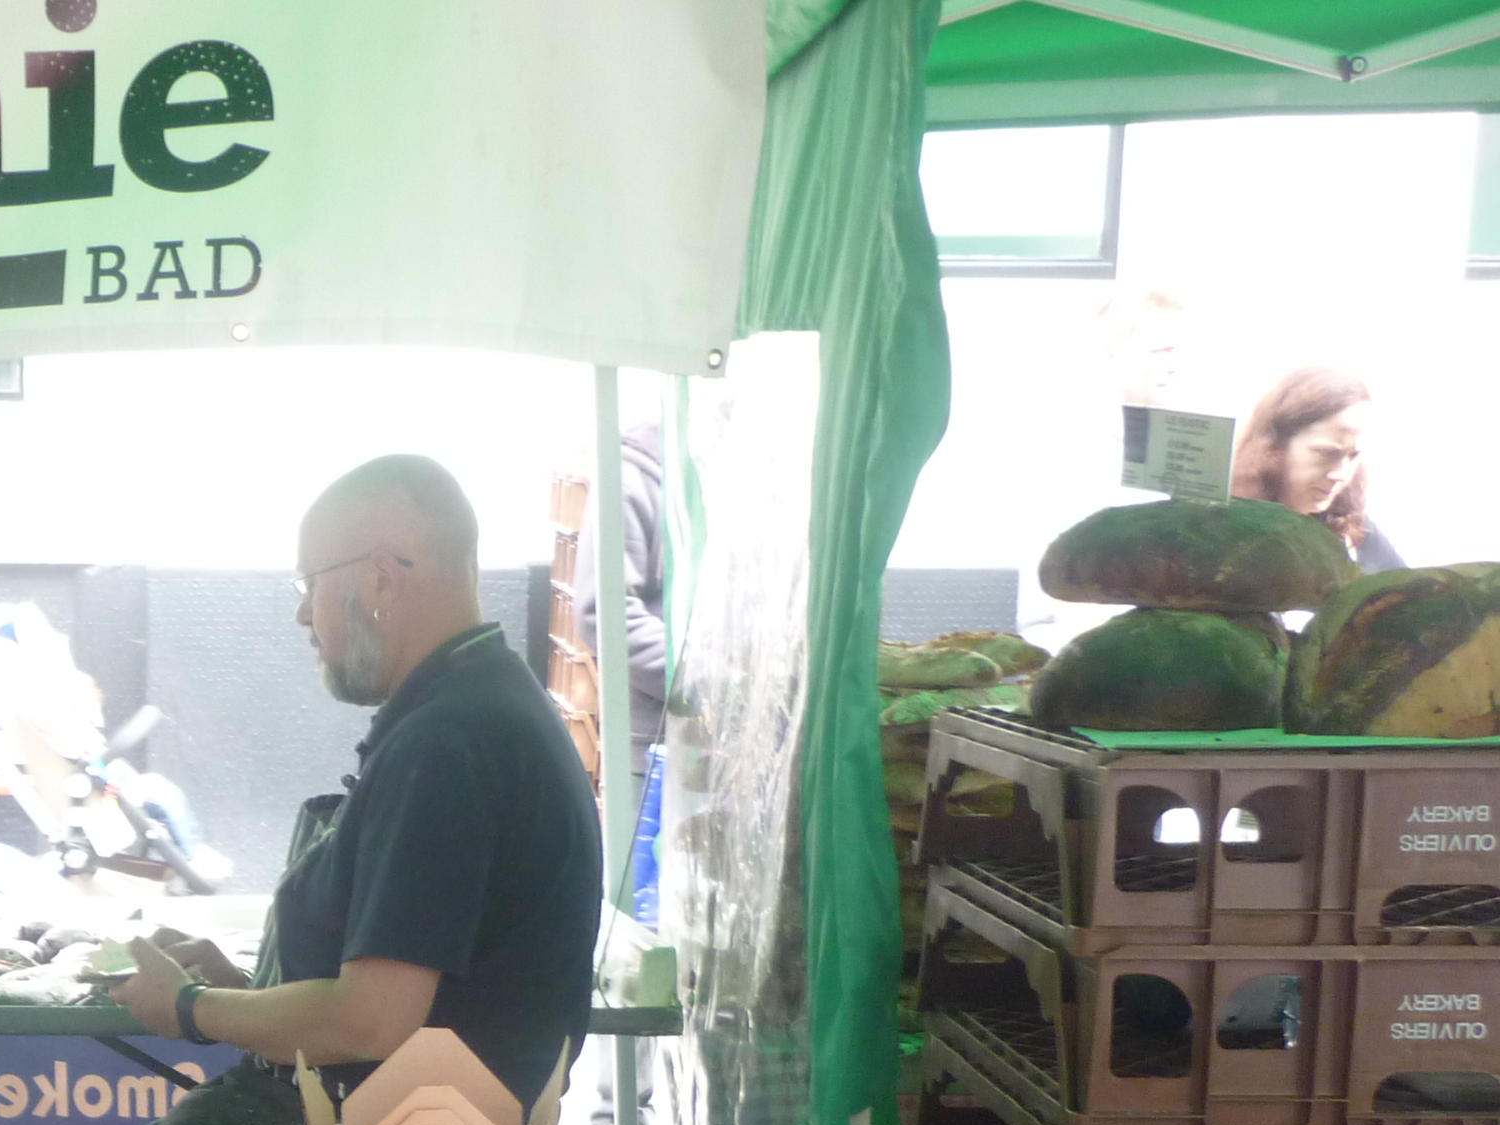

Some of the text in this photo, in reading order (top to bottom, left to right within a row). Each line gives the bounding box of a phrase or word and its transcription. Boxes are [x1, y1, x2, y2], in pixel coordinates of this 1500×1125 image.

[83, 236, 262, 304] BAD
[1406, 805, 1491, 822] BAKERY
[1399, 833, 1497, 852] OLIVIERS
[1396, 993, 1482, 1011] BAKERY
[1389, 1022, 1487, 1040] OLIVIERS
